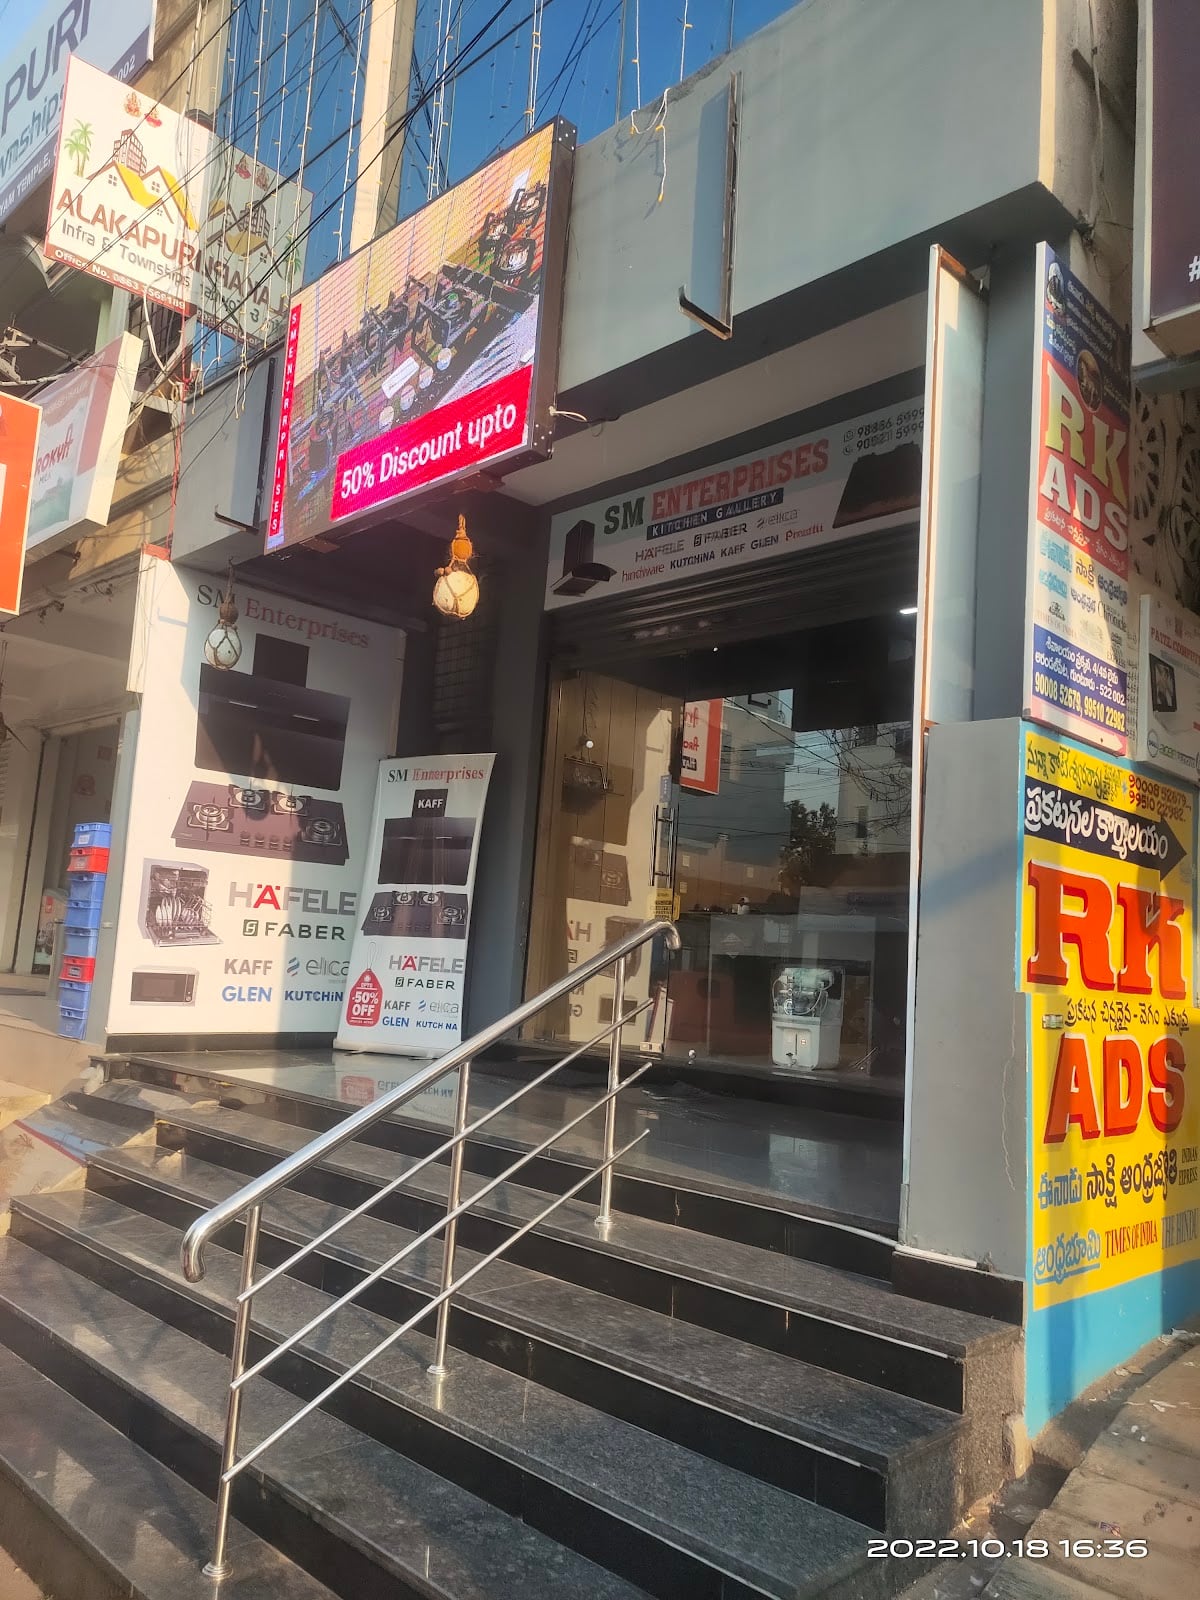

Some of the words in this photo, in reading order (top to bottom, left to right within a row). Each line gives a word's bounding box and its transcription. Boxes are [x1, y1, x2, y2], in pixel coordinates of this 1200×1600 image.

[56, 187, 201, 273] ALAKAPURI
[54, 248, 88, 270] Office
[92, 264, 110, 279] No.
[61, 218, 96, 246] Infra
[101, 237, 113, 251] &
[119, 243, 192, 289] Townships
[340, 462, 375, 500] 50%
[380, 427, 463, 485] Discount
[468, 403, 517, 447] upto
[1044, 359, 1128, 509] RK
[604, 496, 645, 535] SM
[651, 438, 831, 522] ENTERPRISES
[1039, 453, 1128, 552] ADS
[652, 513, 708, 538] KITCHEN
[716, 491, 779, 523] GALLERY
[703, 522, 748, 545] FABER
[766, 508, 798, 526] elica
[621, 563, 665, 583] hindware
[720, 543, 745, 558] KAFF
[750, 535, 779, 551] GLEN
[1075, 558, 1095, 589] సాక్షి
[196, 584, 237, 609] SM
[245, 598, 370, 649] Enterprises
[1034, 671, 1058, 701] 90008
[1059, 683, 1083, 717] 52679,
[1084, 695, 1105, 723] 99510
[1105, 706, 1126, 732] 22982
[1099, 684, 1113, 700] 522
[387, 768, 409, 784] SM
[412, 765, 485, 783] Enterprises
[1128, 773, 1160, 799] 90008
[417, 798, 444, 809] KAFF
[1128, 789, 1156, 812] 99510
[1024, 786, 1095, 843] ప్రకటనల
[1094, 807, 1169, 860] కార్యాలయం
[228, 881, 357, 917] HÄFELE
[264, 922, 345, 941] FABER
[1026, 858, 1187, 1002] RK
[223, 958, 273, 976] KAFF
[305, 956, 350, 977] elica
[406, 977, 456, 991] FABER
[221, 985, 272, 1003] GLEN
[351, 1003, 375, 1018] OFF
[383, 999, 411, 1012] KAFF
[429, 1000, 459, 1014] elica
[382, 1016, 410, 1028] GLEN
[1064, 998, 1097, 1033] ప్రకటన
[1042, 1031, 1187, 1145] ADS
[1037, 1165, 1083, 1211] ఈనాడు
[1086, 1153, 1118, 1209] సాక్షి
[1119, 1144, 1178, 1205] ఆంధ్రజ్యోతి
[1104, 1225, 1131, 1260] TIMES
[1131, 1224, 1139, 1255] OF
[1139, 1220, 1159, 1252] INDIA
[1160, 1214, 1175, 1251] THE
[1175, 1207, 1200, 1248] HINDU
[1034, 1227, 1102, 1285] ఆంధ్రభూమి
